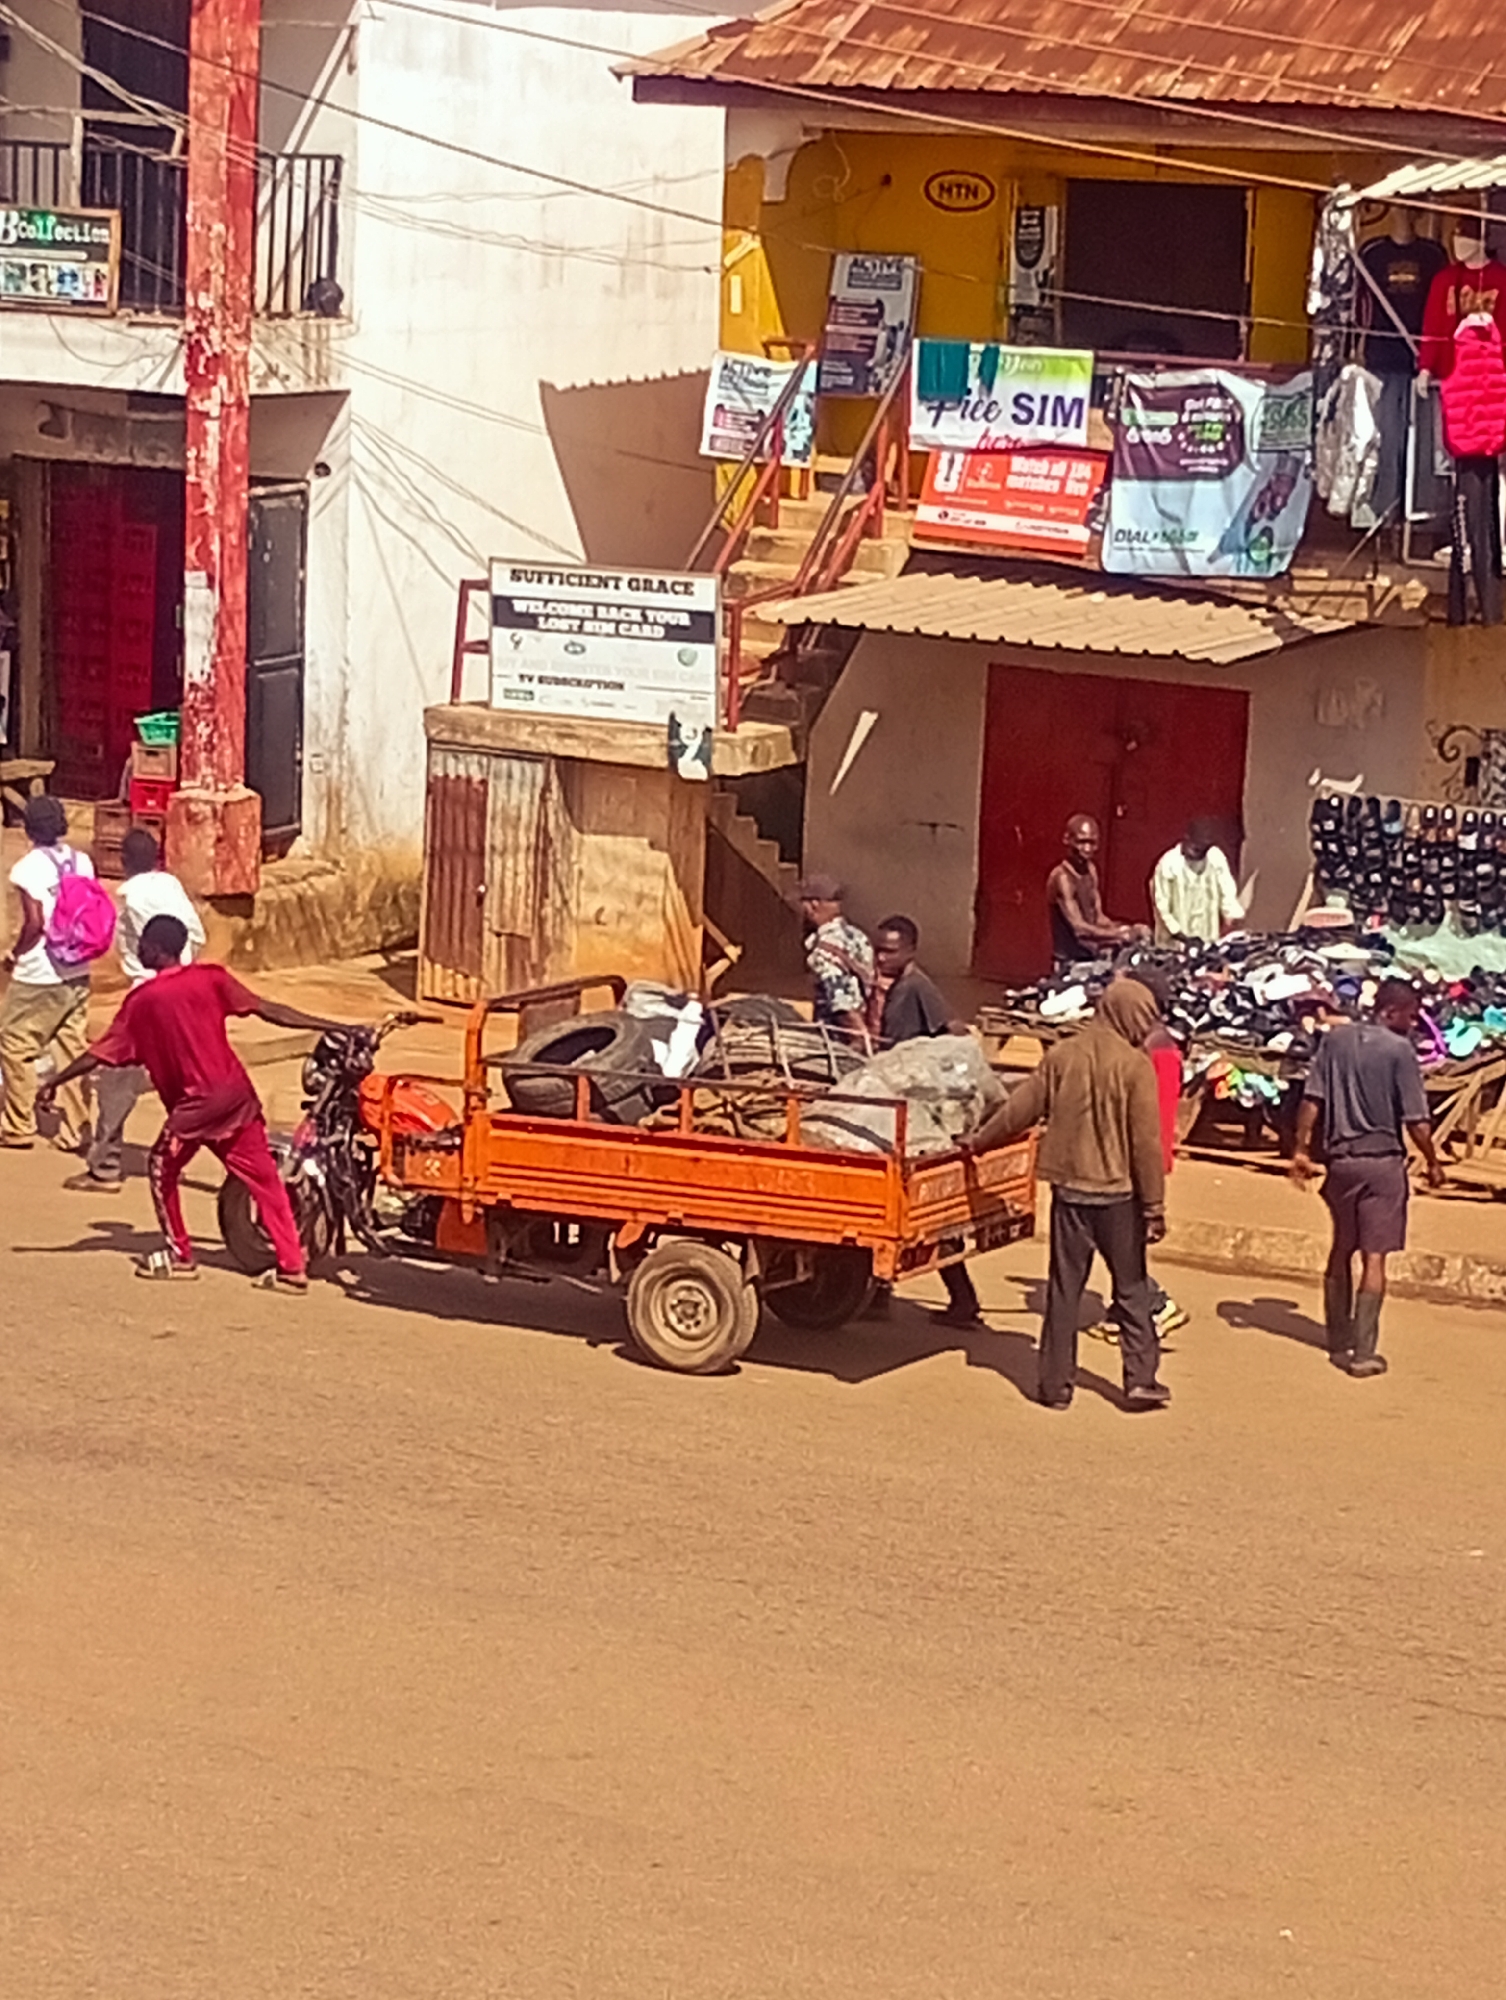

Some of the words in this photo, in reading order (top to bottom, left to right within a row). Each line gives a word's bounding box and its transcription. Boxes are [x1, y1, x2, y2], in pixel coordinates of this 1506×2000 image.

[938, 182, 980, 200] MTN
[1011, 392, 1085, 429] SIM
[1114, 528, 1151, 544] DIAL
[509, 569, 622, 590] SUFFICIENT
[626, 577, 695, 596] GRACE
[511, 600, 595, 619] WELCOME
[645, 608, 692, 627] YOUR
[537, 616, 580, 632] LOST
[582, 620, 616, 635] SIM
[618, 623, 666, 639] CARD
